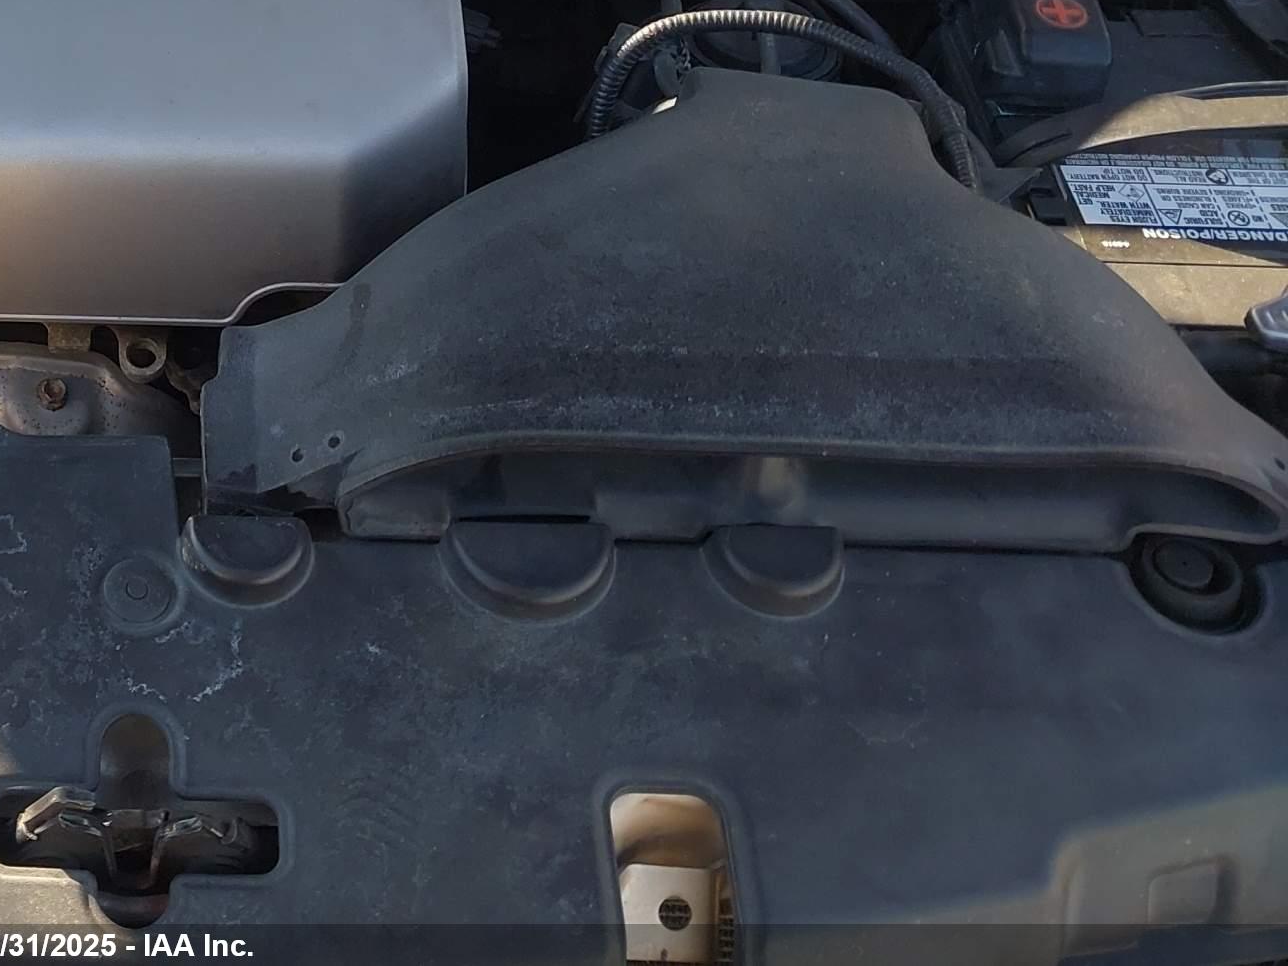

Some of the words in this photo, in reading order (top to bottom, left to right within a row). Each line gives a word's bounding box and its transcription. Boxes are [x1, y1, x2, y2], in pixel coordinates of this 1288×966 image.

[1073, 190, 1110, 198] MEDICAL
[1129, 201, 1151, 209] WITH
[1099, 207, 1153, 216] IMMEDIATELY
[1142, 228, 1288, 241] DANGER/POISON
